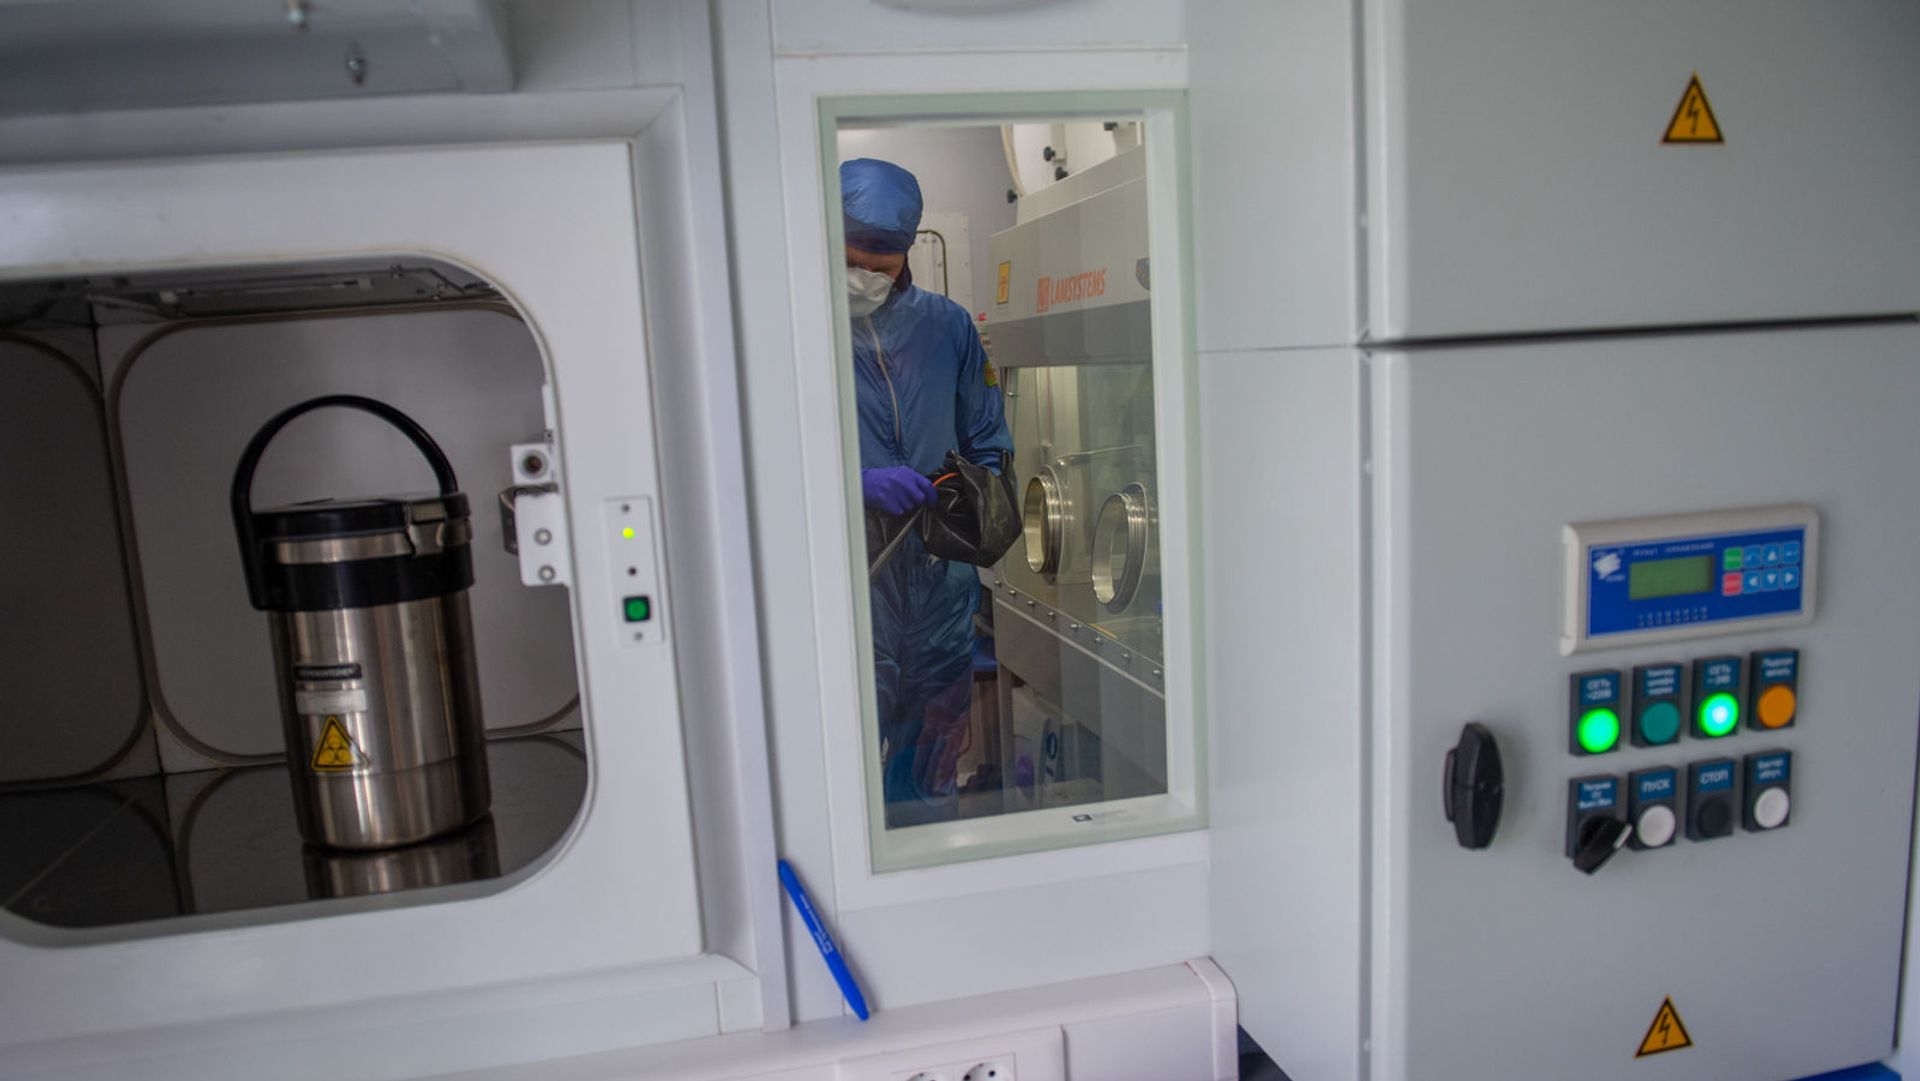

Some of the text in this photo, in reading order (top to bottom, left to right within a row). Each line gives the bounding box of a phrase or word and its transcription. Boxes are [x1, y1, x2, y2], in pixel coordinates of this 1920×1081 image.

[1051, 269, 1105, 304] LAMSYSTEMS
[1699, 769, 1729, 785] СТОП
[1641, 778, 1671, 794] ПУСК
